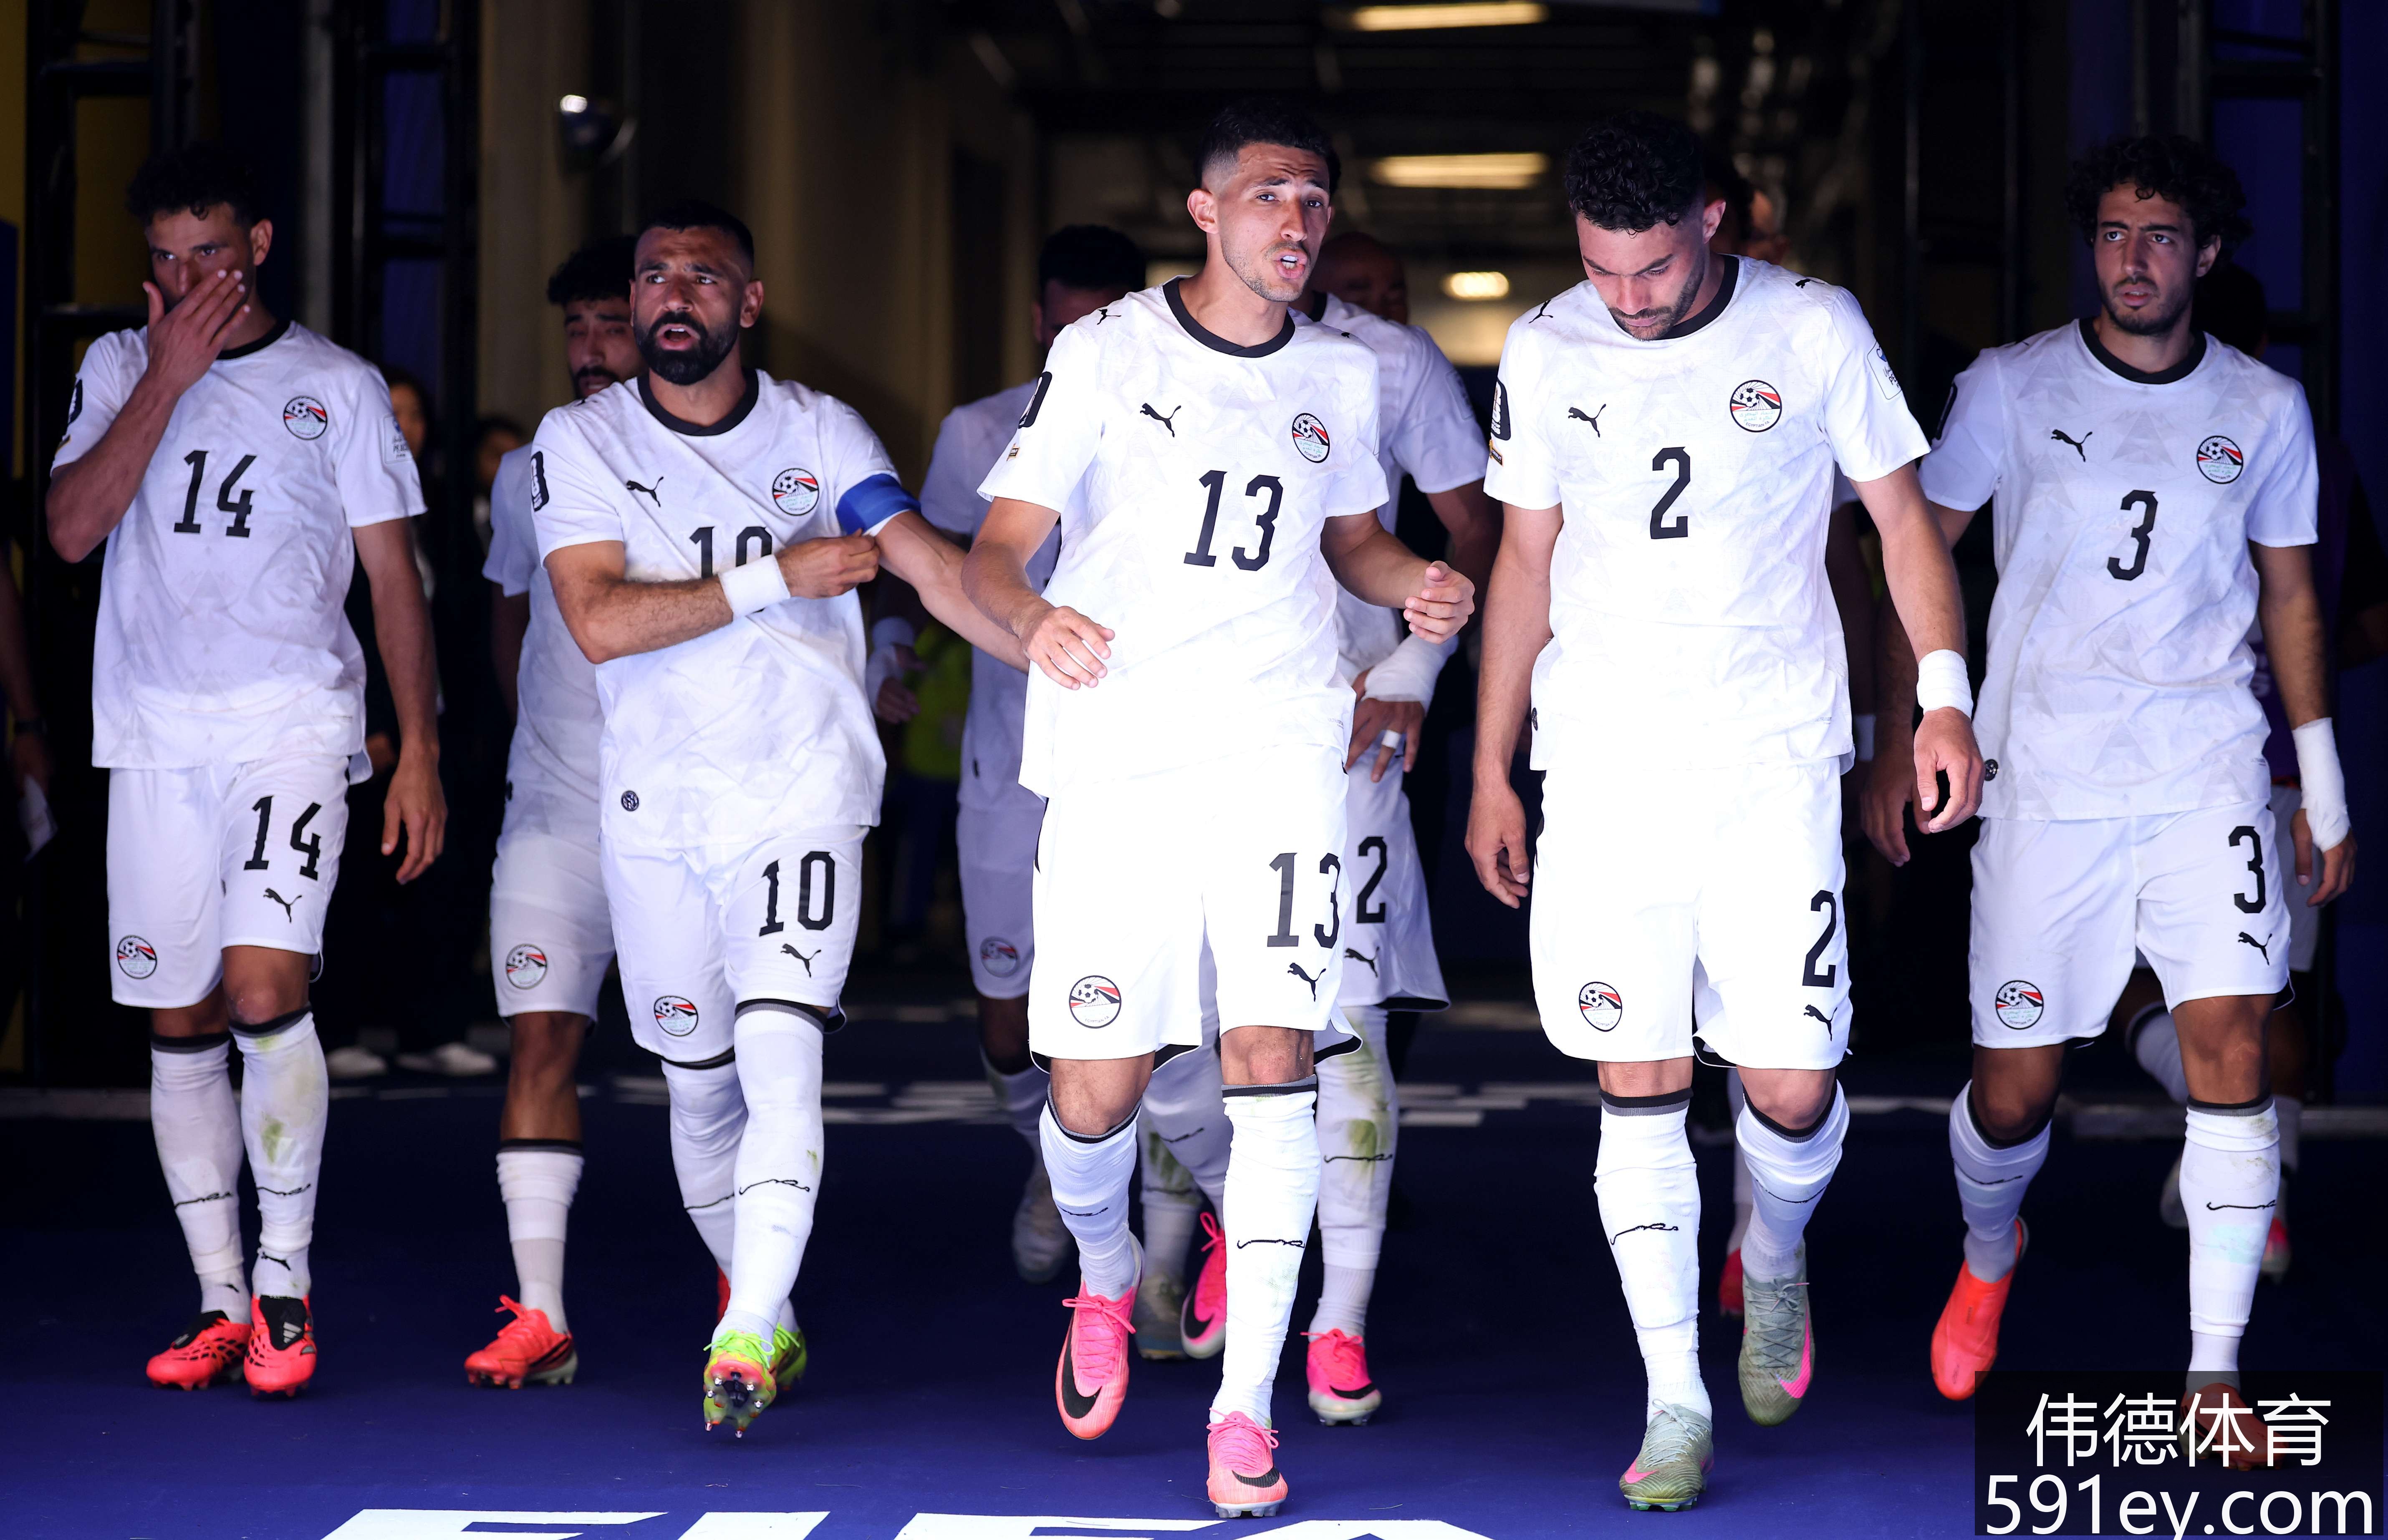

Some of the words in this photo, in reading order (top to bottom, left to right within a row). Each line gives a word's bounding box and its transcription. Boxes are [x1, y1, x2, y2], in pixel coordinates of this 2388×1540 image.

[174, 450, 257, 538] 14
[1184, 470, 1283, 571] 13
[1650, 447, 1690, 539] 2
[2103, 490, 2158, 581] 3
[244, 796, 322, 881] 14
[2228, 826, 2266, 914] 3
[759, 851, 835, 937] 10
[1267, 852, 1340, 949] 13
[1802, 890, 1837, 988] 2
